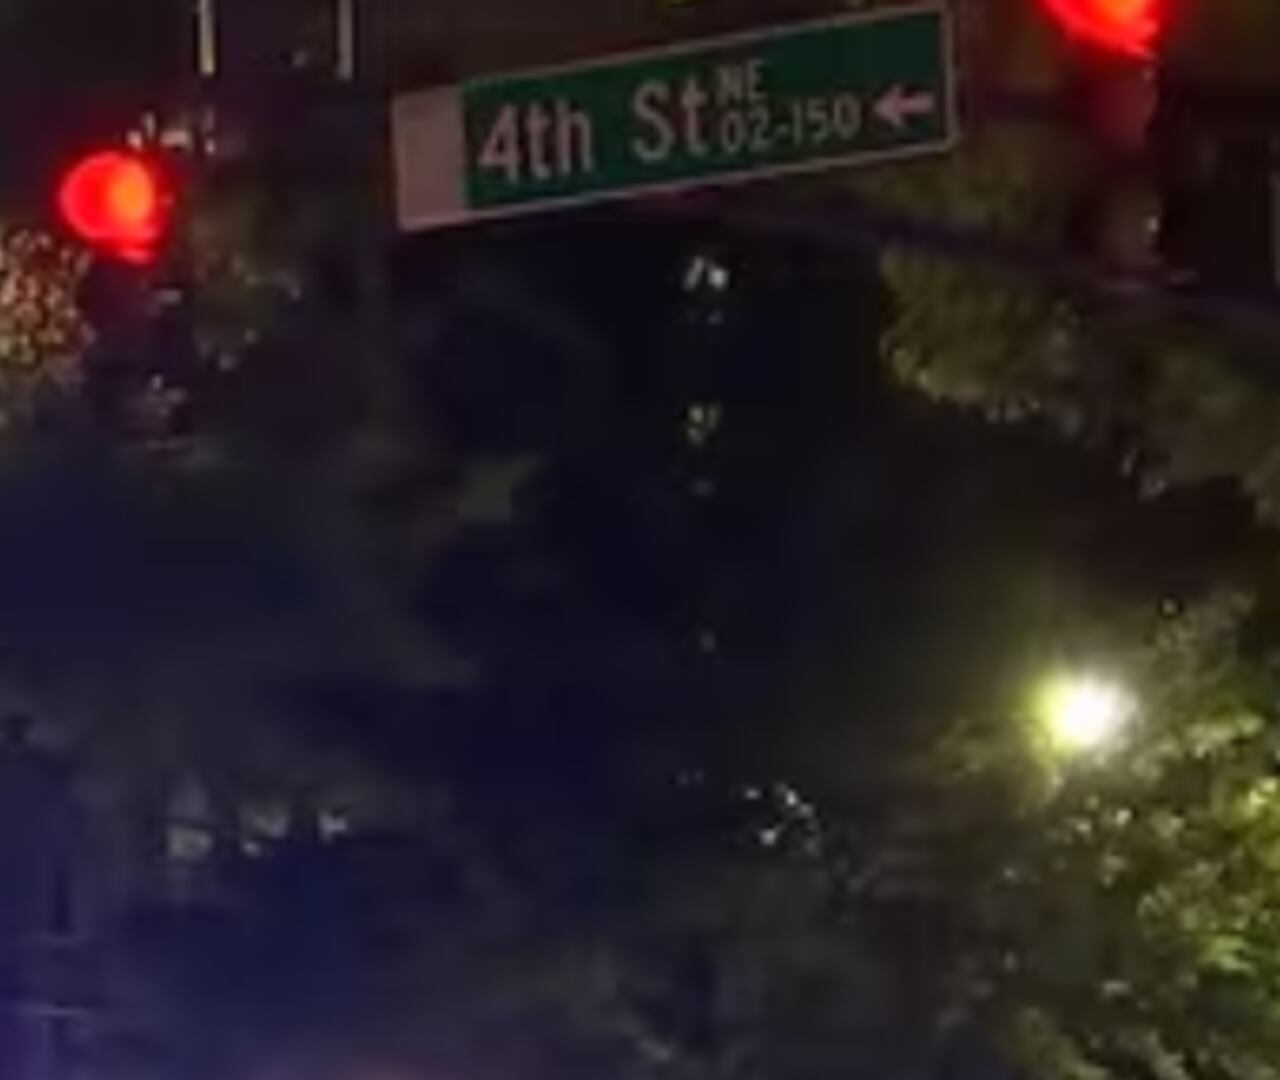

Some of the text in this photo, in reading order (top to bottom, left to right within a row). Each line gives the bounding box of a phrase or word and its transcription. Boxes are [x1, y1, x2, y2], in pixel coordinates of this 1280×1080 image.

[478, 57, 766, 184] 4th St NE
[720, 94, 862, 153] 02-150
